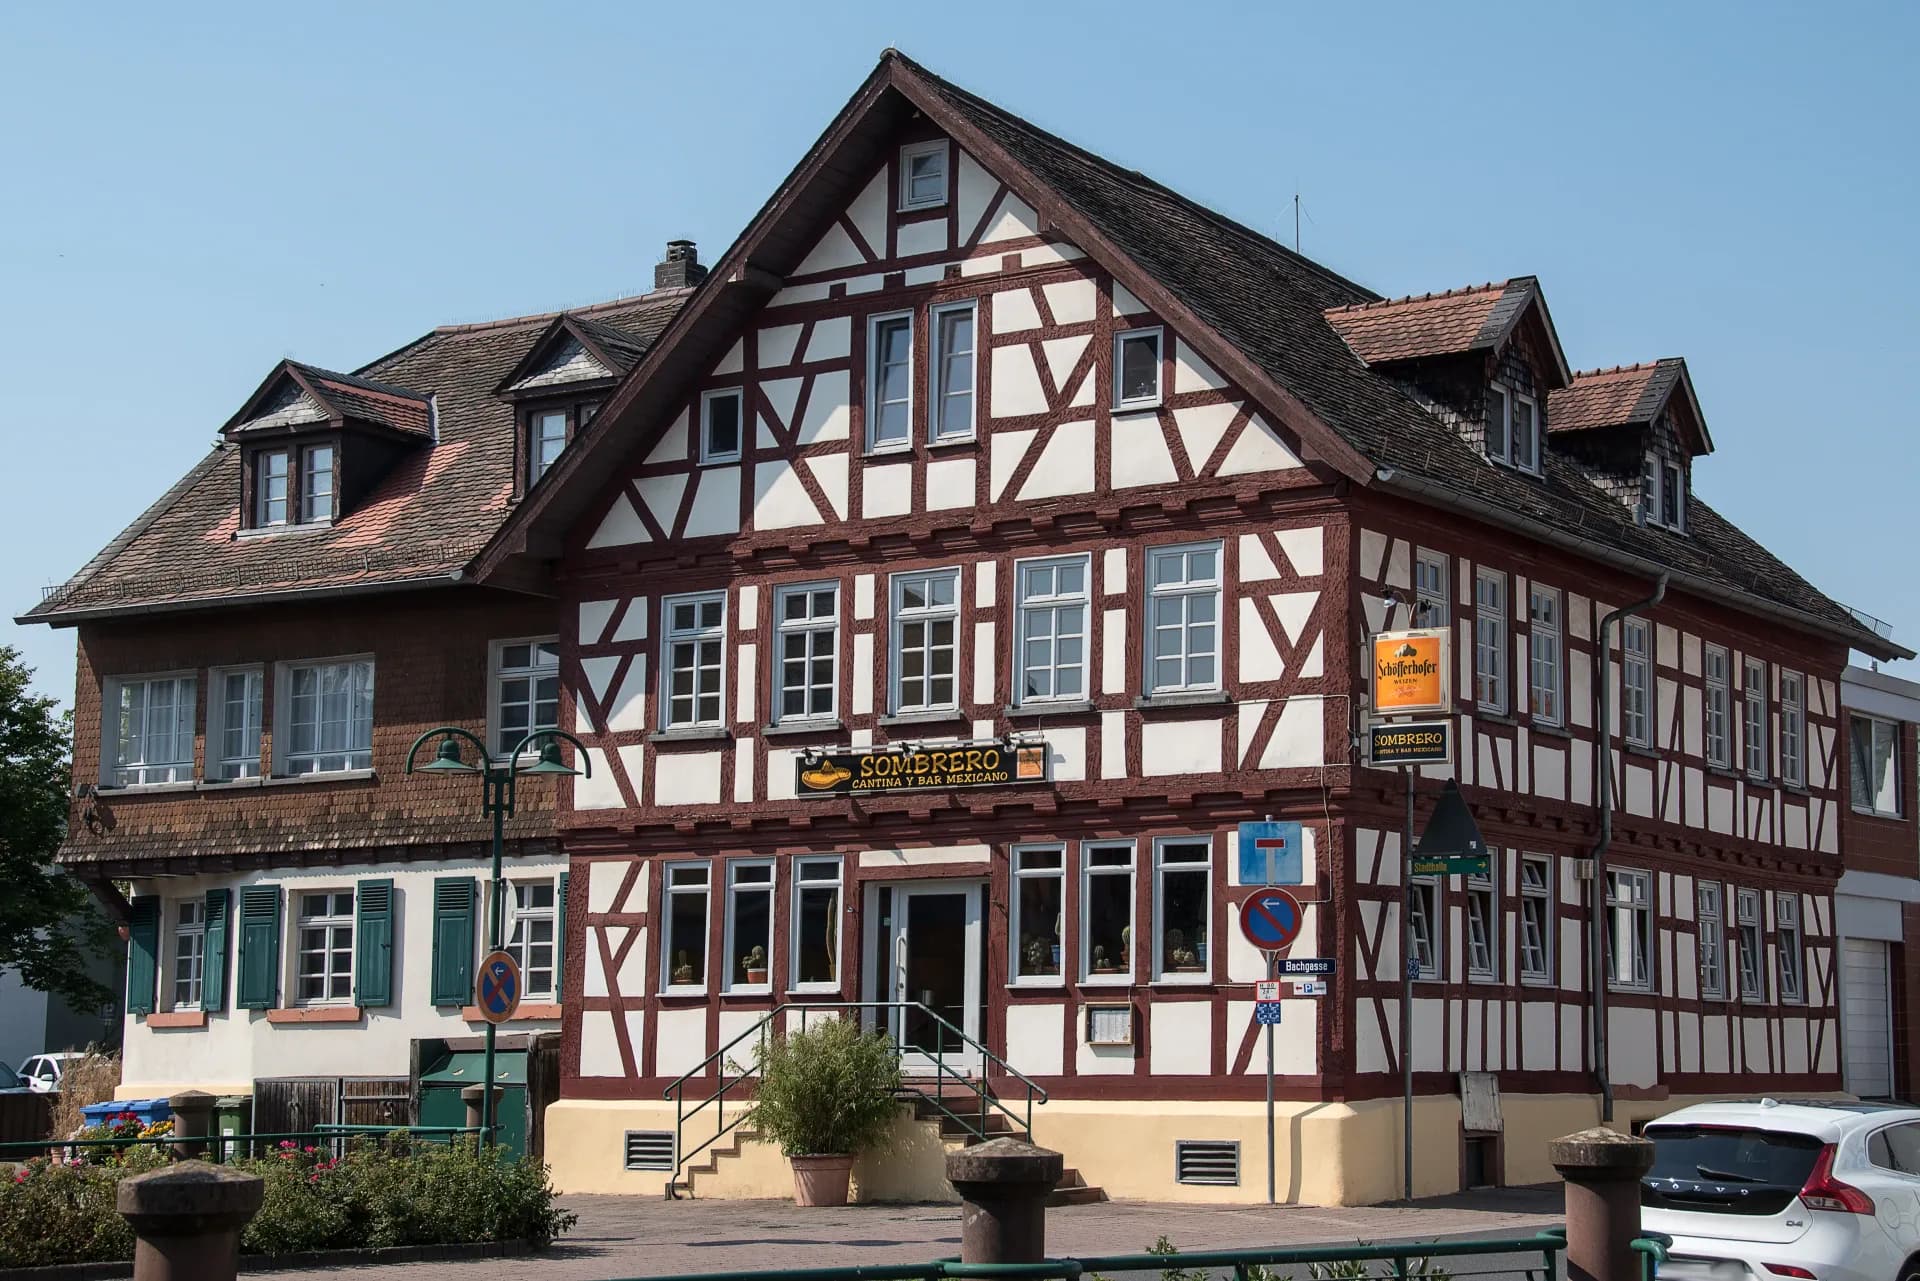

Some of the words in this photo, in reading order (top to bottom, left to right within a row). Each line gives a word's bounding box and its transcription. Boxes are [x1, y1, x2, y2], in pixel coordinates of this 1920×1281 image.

[1378, 659, 1437, 679] Schöfferhofer
[1374, 732, 1442, 746] SOMBRERO
[860, 749, 1000, 777] SOMBRERO
[852, 777, 902, 789] CANTINA
[905, 776, 913, 787] Y
[918, 775, 942, 785] BAR
[946, 771, 1008, 784] MEXICANO
[1285, 960, 1328, 973] Bachgasse
[1305, 984, 1312, 993] P
[1650, 1182, 1749, 1195] VOLVO
